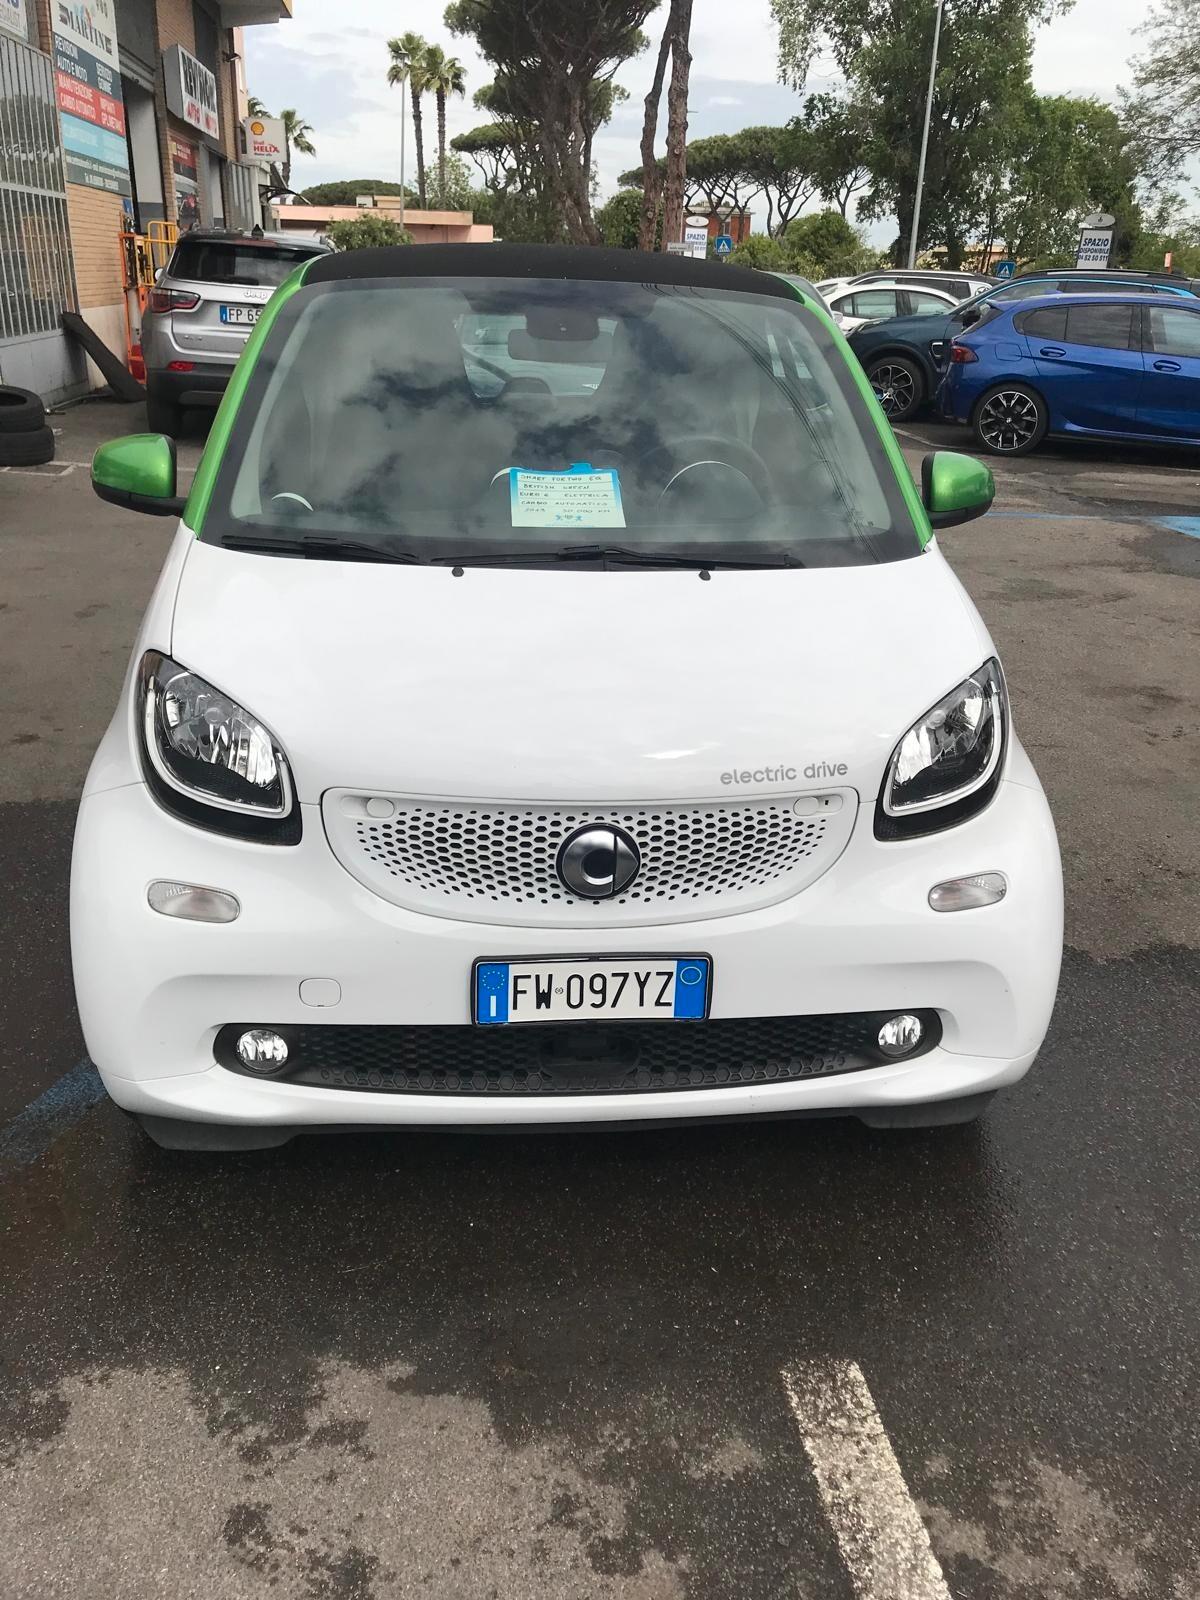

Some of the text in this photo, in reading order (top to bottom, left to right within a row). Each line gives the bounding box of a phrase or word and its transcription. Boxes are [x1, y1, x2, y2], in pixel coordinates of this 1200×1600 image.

[253, 144, 280, 153] HELIX
[1083, 238, 1109, 246] SPAZIO
[244, 290, 267, 300] Jeep
[720, 761, 849, 785] electric drive
